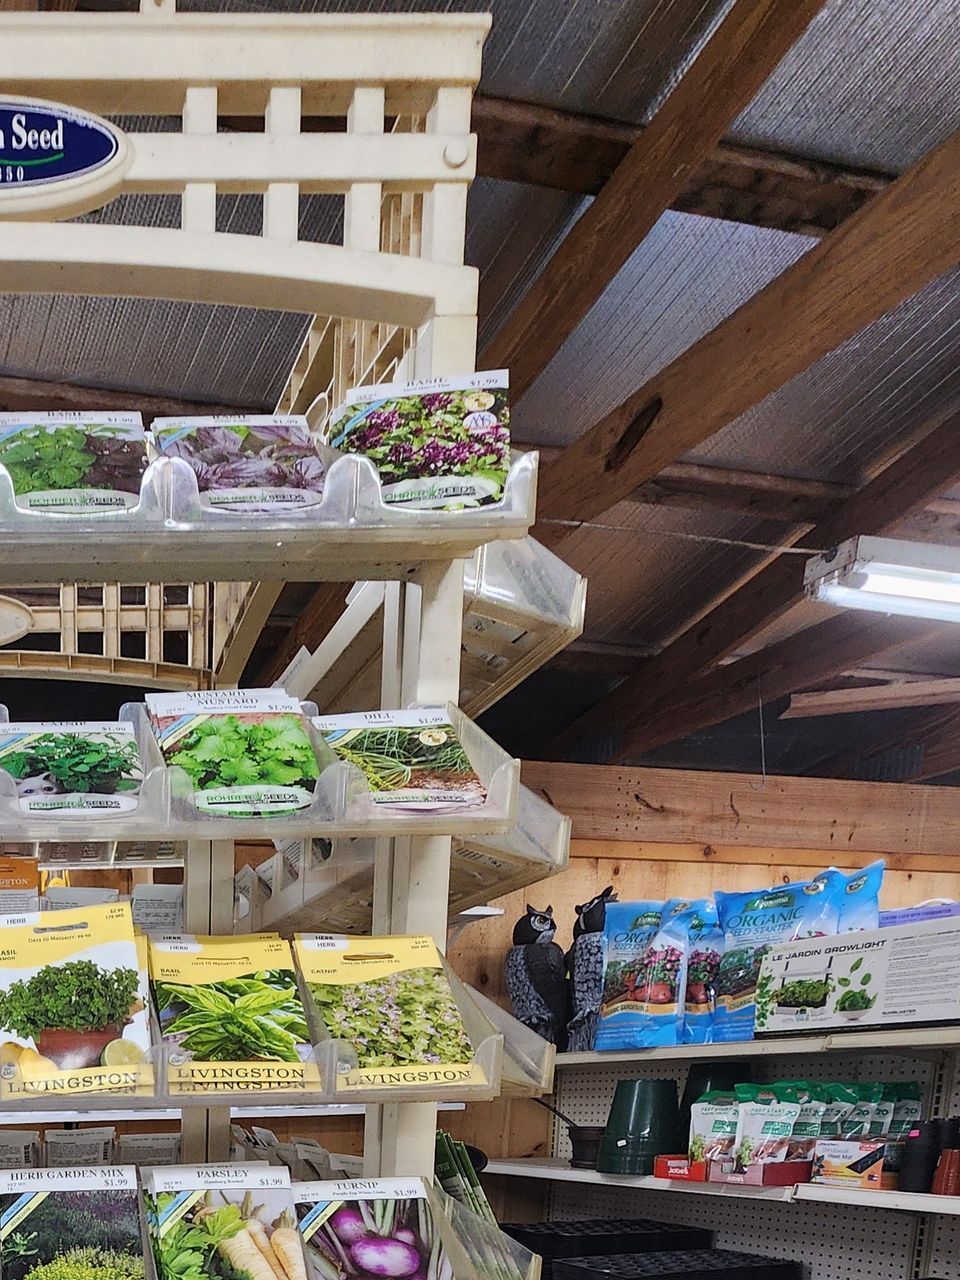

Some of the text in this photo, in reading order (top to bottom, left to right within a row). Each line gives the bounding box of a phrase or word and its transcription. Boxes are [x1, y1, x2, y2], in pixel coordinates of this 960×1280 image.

[12, 114, 64, 150] Seed
[437, 484, 477, 497] SEEDS
[197, 697, 259, 706] MUSTARD
[418, 717, 444, 725] $1.99
[263, 792, 299, 801] SEEDS
[6, 918, 27, 926] HERB
[727, 905, 804, 930] ORGANIC
[772, 940, 888, 961] LE JARDIN GROWLIGHT
[177, 1067, 305, 1079] LIVINGSTON
[8, 1072, 138, 1094] LIVINGSTON
[346, 1070, 471, 1087] LIVINGSTON
[10, 1168, 124, 1182] HERB GARDEN MIX
[197, 1169, 249, 1179] PARSLEY
[104, 1178, 128, 1188] $1.99
[260, 1179, 283, 1187] $1.99
[334, 1181, 379, 1190] TURNIP
[394, 1188, 418, 1197] $1.99
